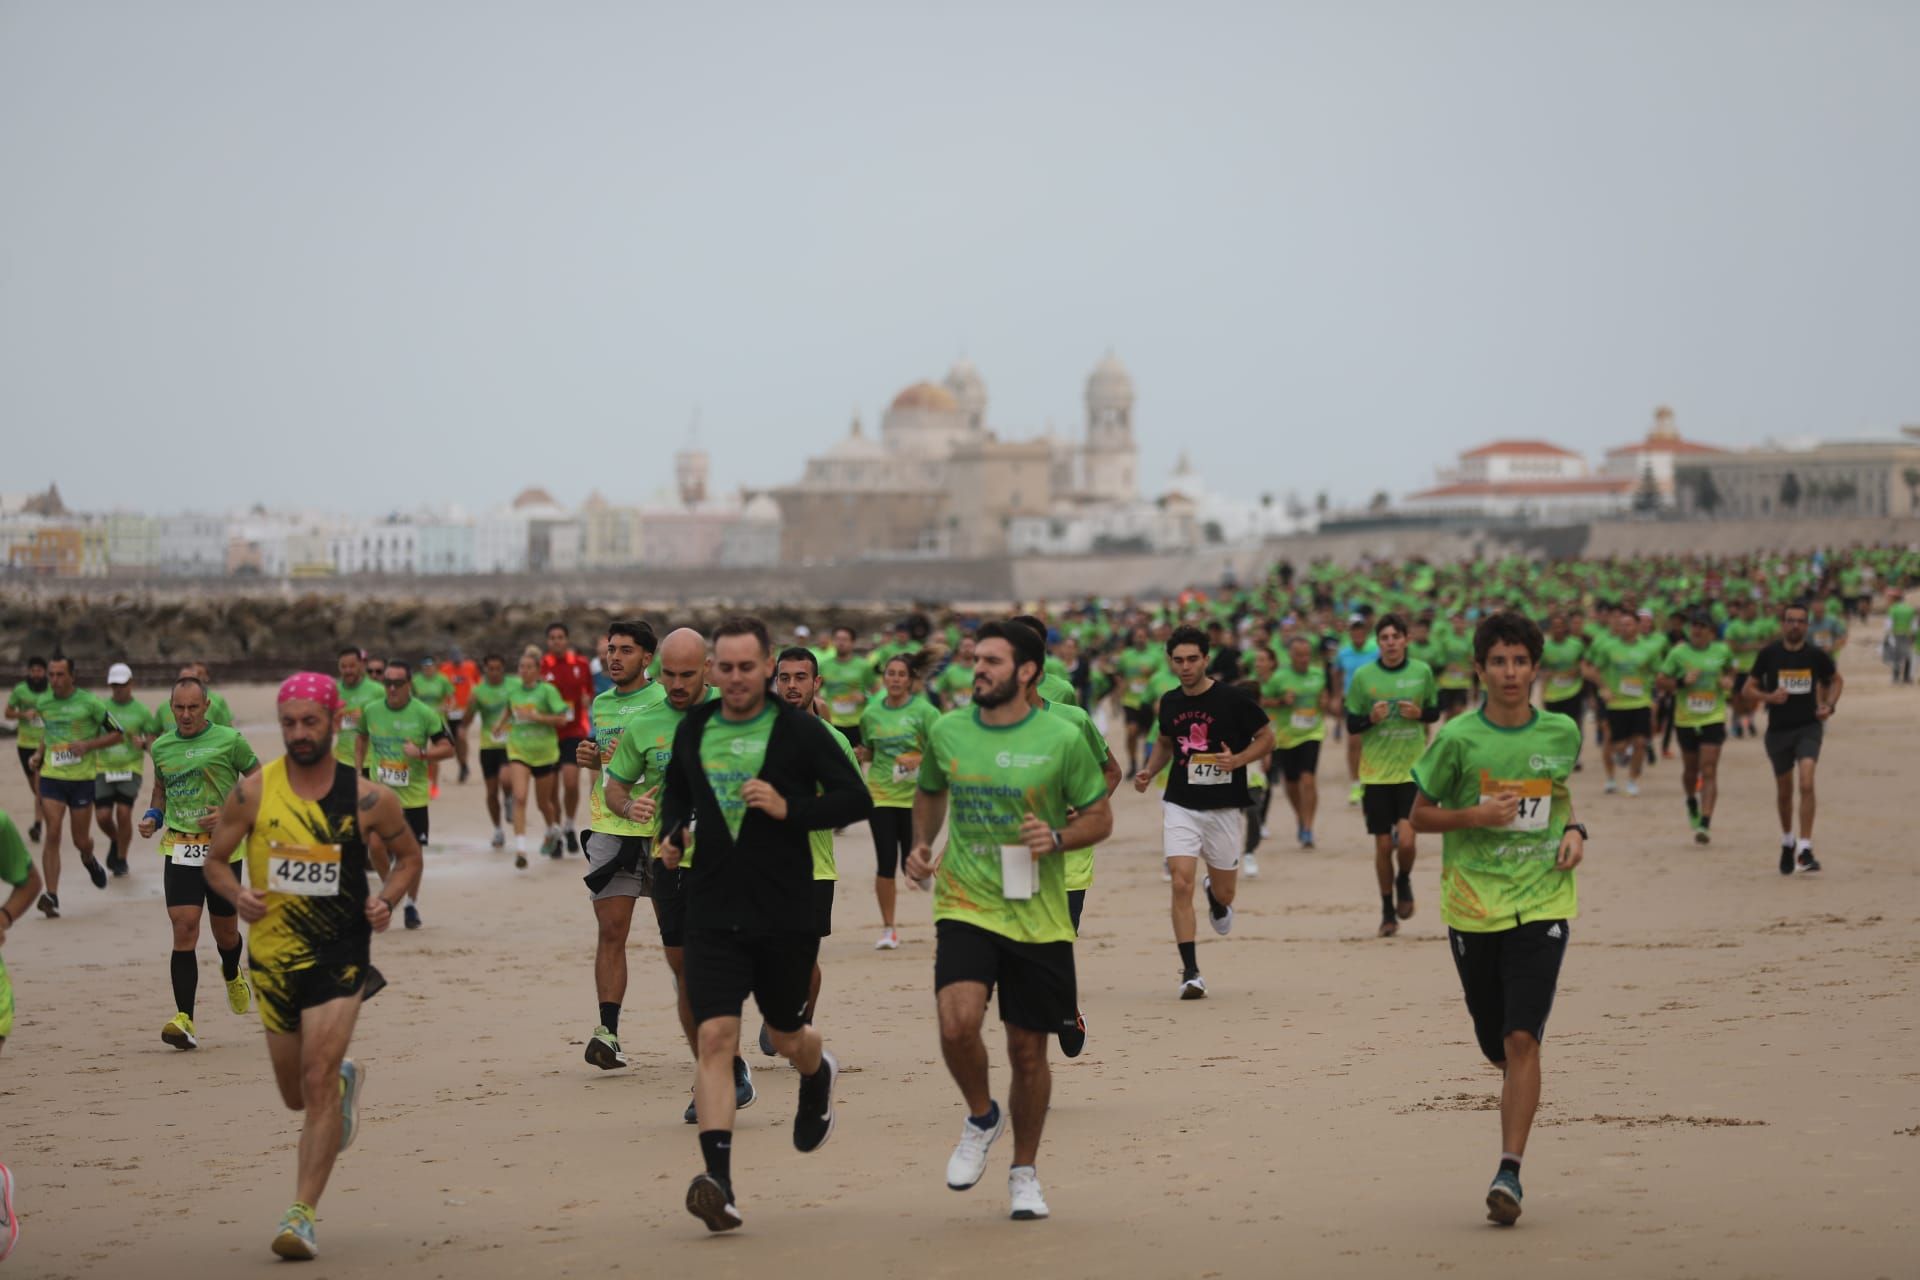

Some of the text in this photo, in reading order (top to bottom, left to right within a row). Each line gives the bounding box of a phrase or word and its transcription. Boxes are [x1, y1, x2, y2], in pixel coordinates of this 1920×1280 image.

[1195, 764, 1229, 776] 479
[966, 783, 1022, 799] marcha
[1518, 797, 1541, 818] 47
[277, 859, 337, 883] 4285
